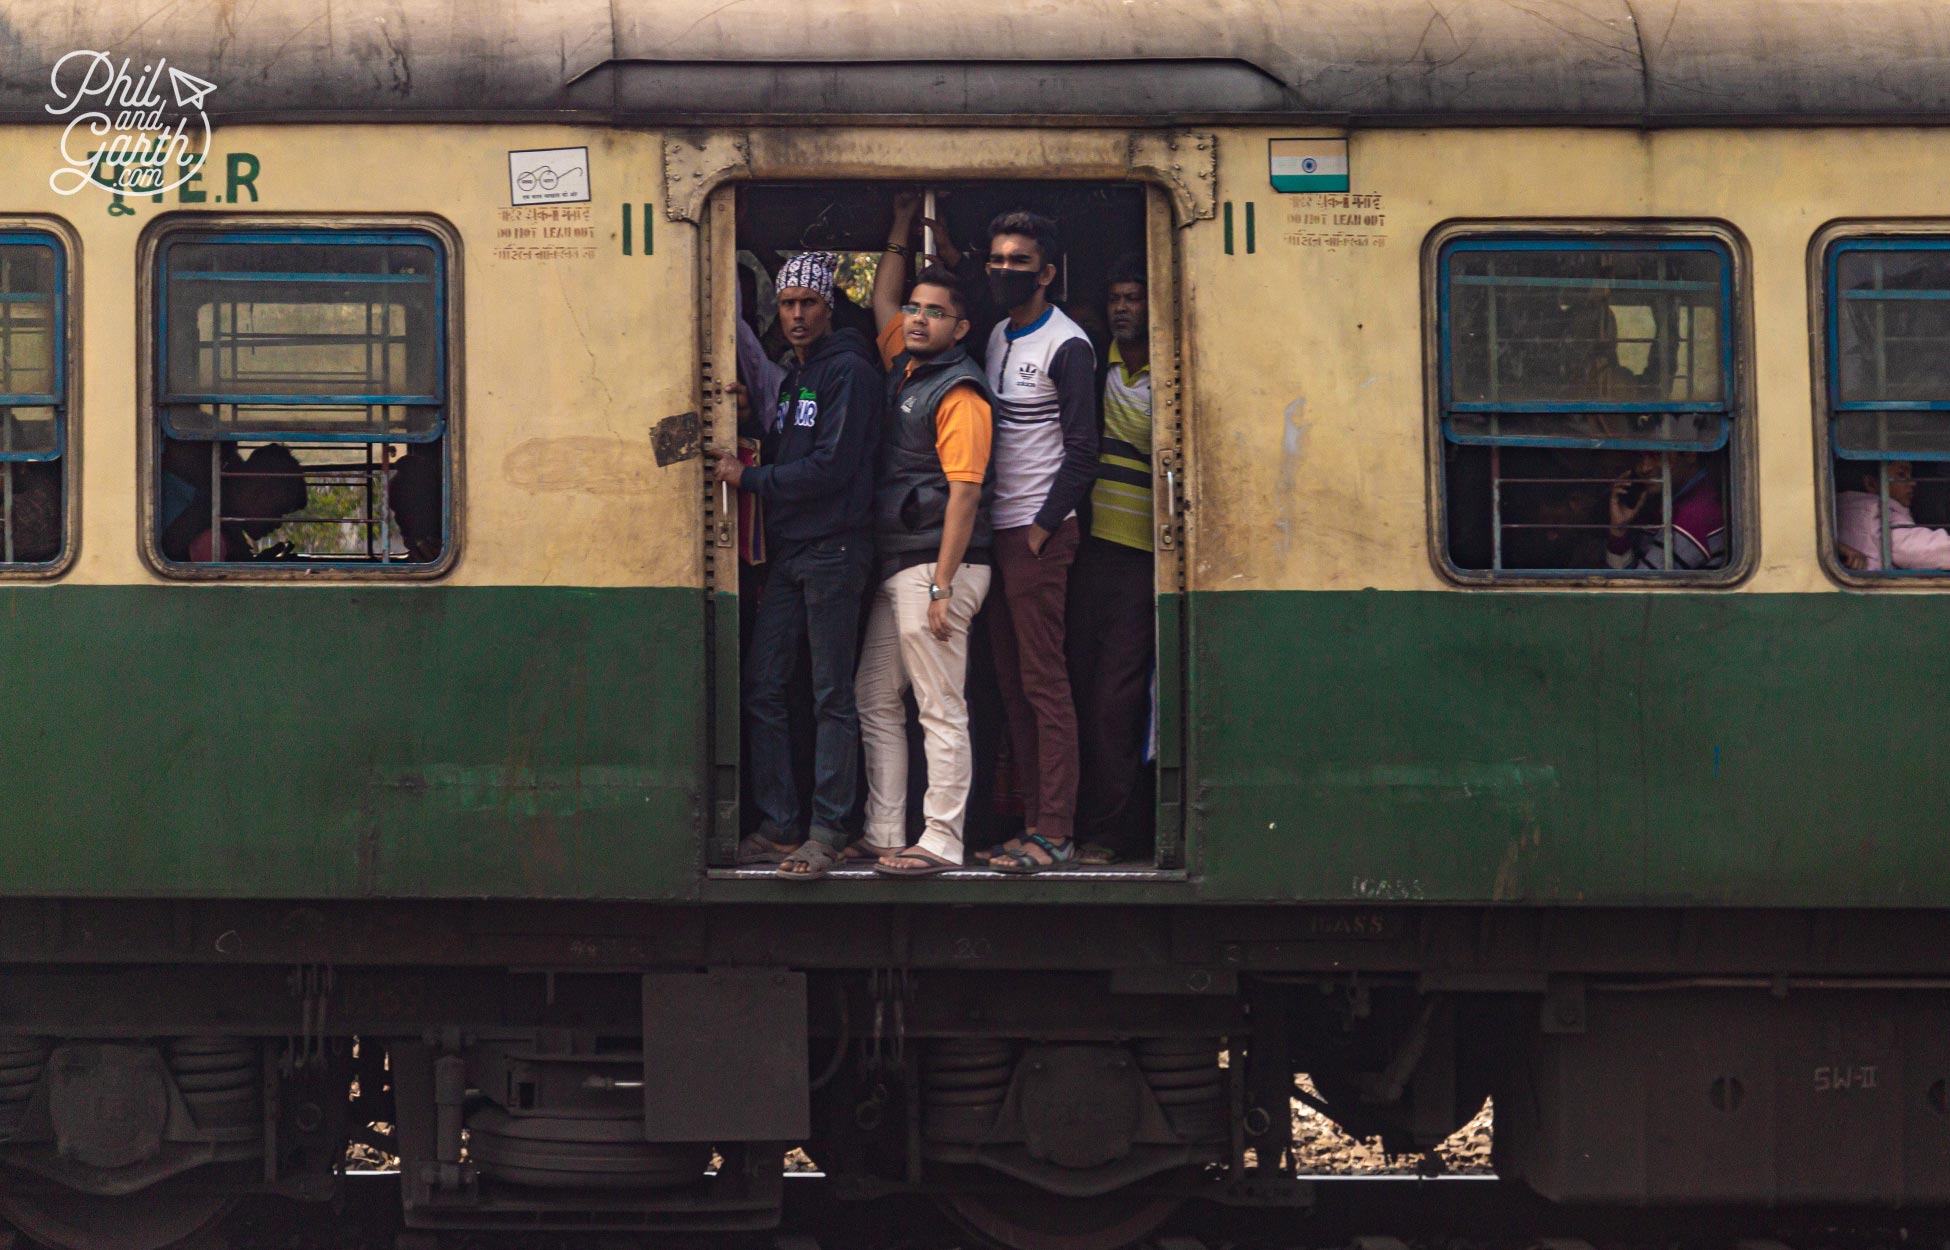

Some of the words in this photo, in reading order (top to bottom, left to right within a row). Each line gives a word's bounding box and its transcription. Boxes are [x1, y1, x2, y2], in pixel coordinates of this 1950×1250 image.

[1303, 213, 1328, 225] NOT
[1333, 213, 1362, 226] LEAN
[1363, 214, 1386, 226] OUT
[497, 227, 512, 239] DO
[513, 227, 537, 239] NOT
[543, 227, 571, 239] LEAN
[573, 226, 595, 238] OUT
